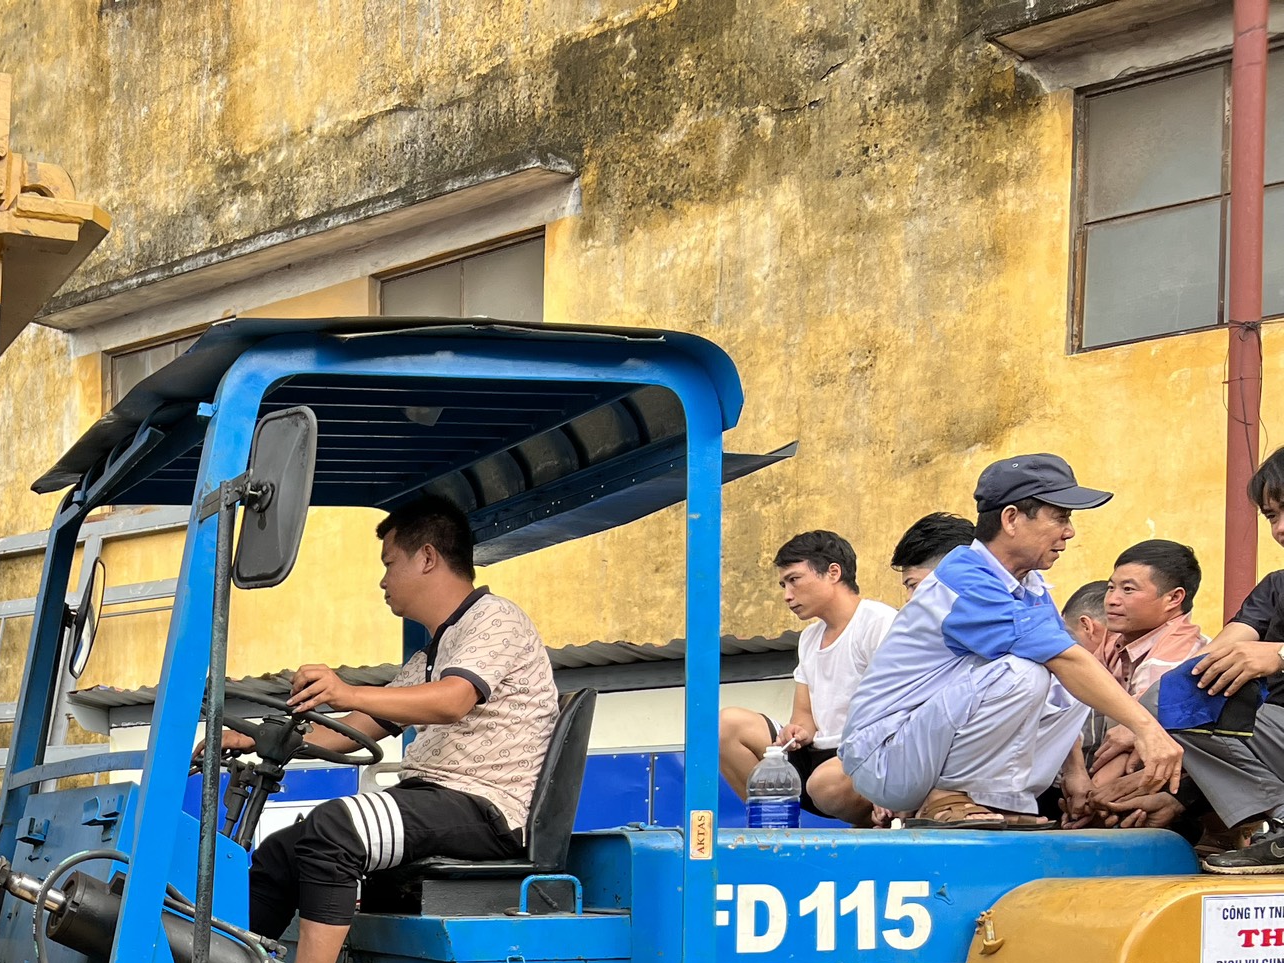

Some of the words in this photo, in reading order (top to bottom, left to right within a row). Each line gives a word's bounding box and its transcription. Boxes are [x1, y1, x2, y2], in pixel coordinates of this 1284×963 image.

[696, 814, 706, 855] AKTAS
[1222, 904, 1251, 920] CÔNG
[1254, 906, 1266, 919] TY
[1269, 905, 1284, 919] TN
[1237, 927, 1284, 948] TH
